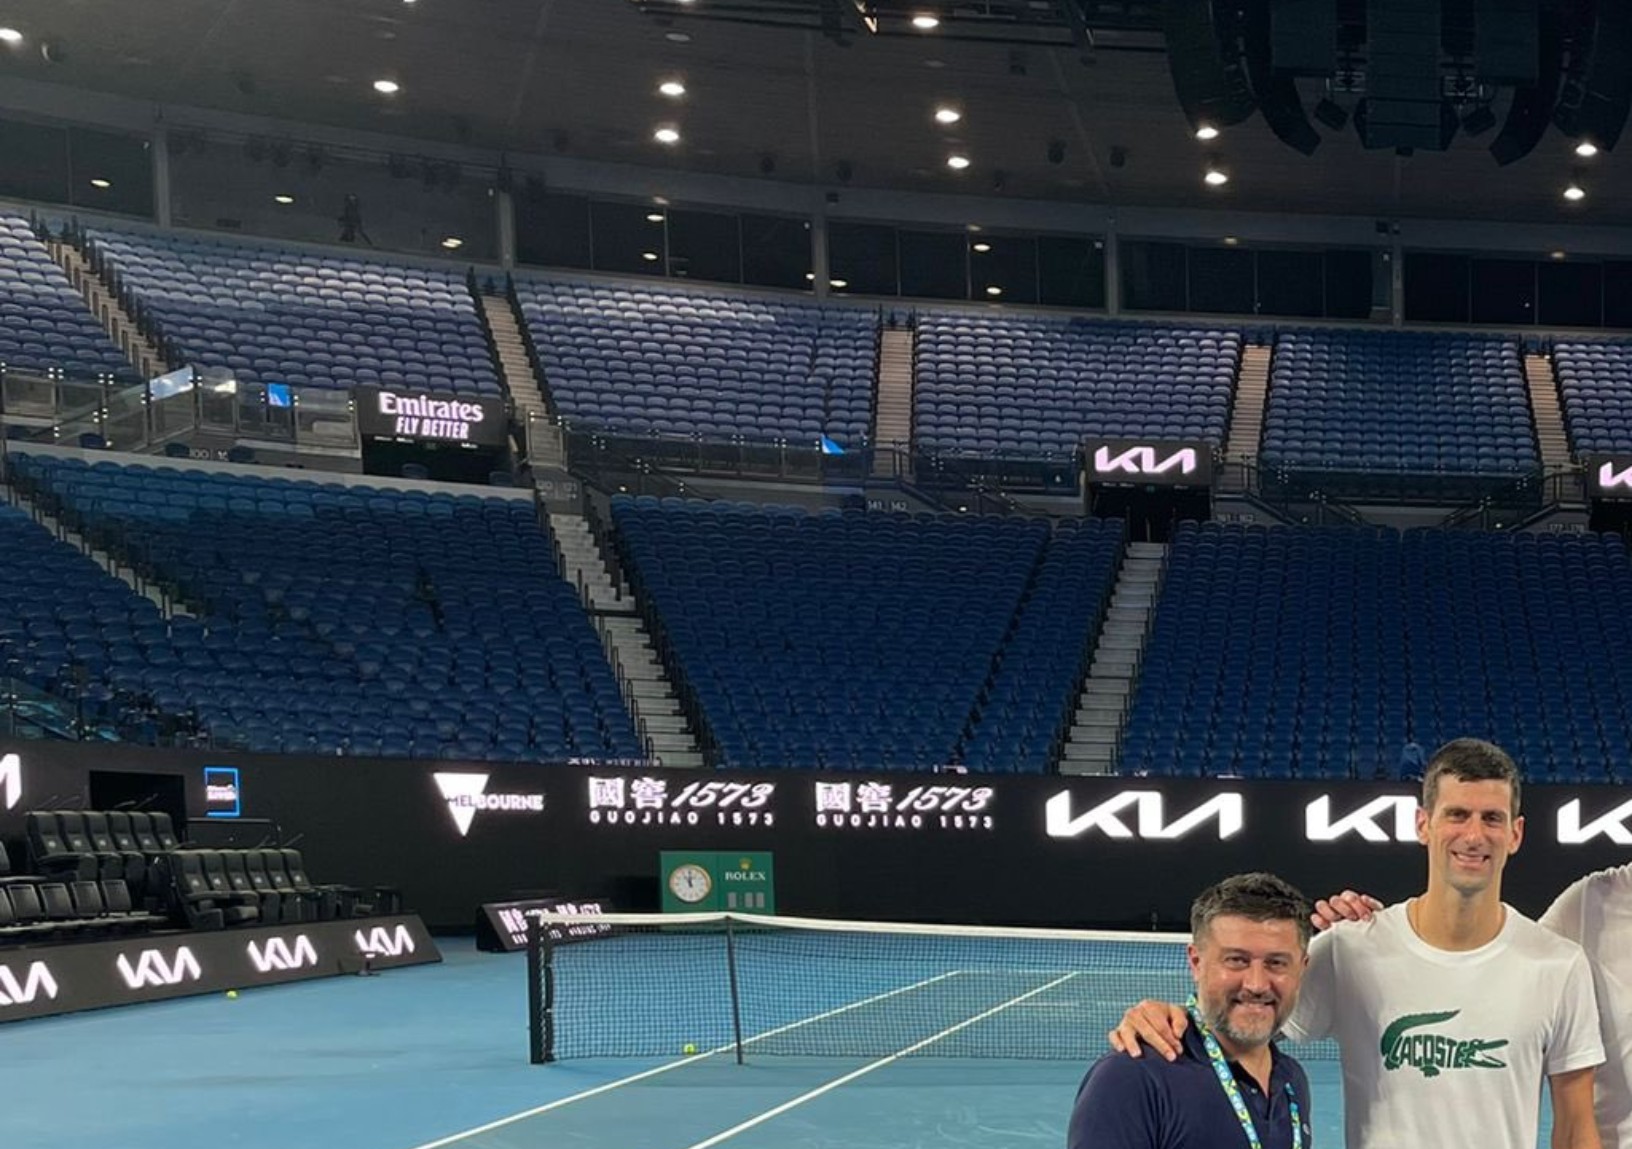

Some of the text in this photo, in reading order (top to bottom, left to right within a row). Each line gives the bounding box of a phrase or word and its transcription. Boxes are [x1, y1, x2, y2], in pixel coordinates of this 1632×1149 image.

[378, 391, 484, 424] Emirates
[395, 416, 470, 440] FLY BETTER
[1095, 445, 1195, 474] KIA
[589, 810, 774, 826] GUOJIAO 1573
[816, 813, 993, 830] GUOJIAO 1573
[1045, 789, 1243, 840] KIA
[1305, 794, 1418, 842] KI
[725, 871, 766, 881] ROLEX
[247, 934, 318, 972] KIA
[355, 925, 415, 958] KIA
[116, 946, 201, 989] KIA
